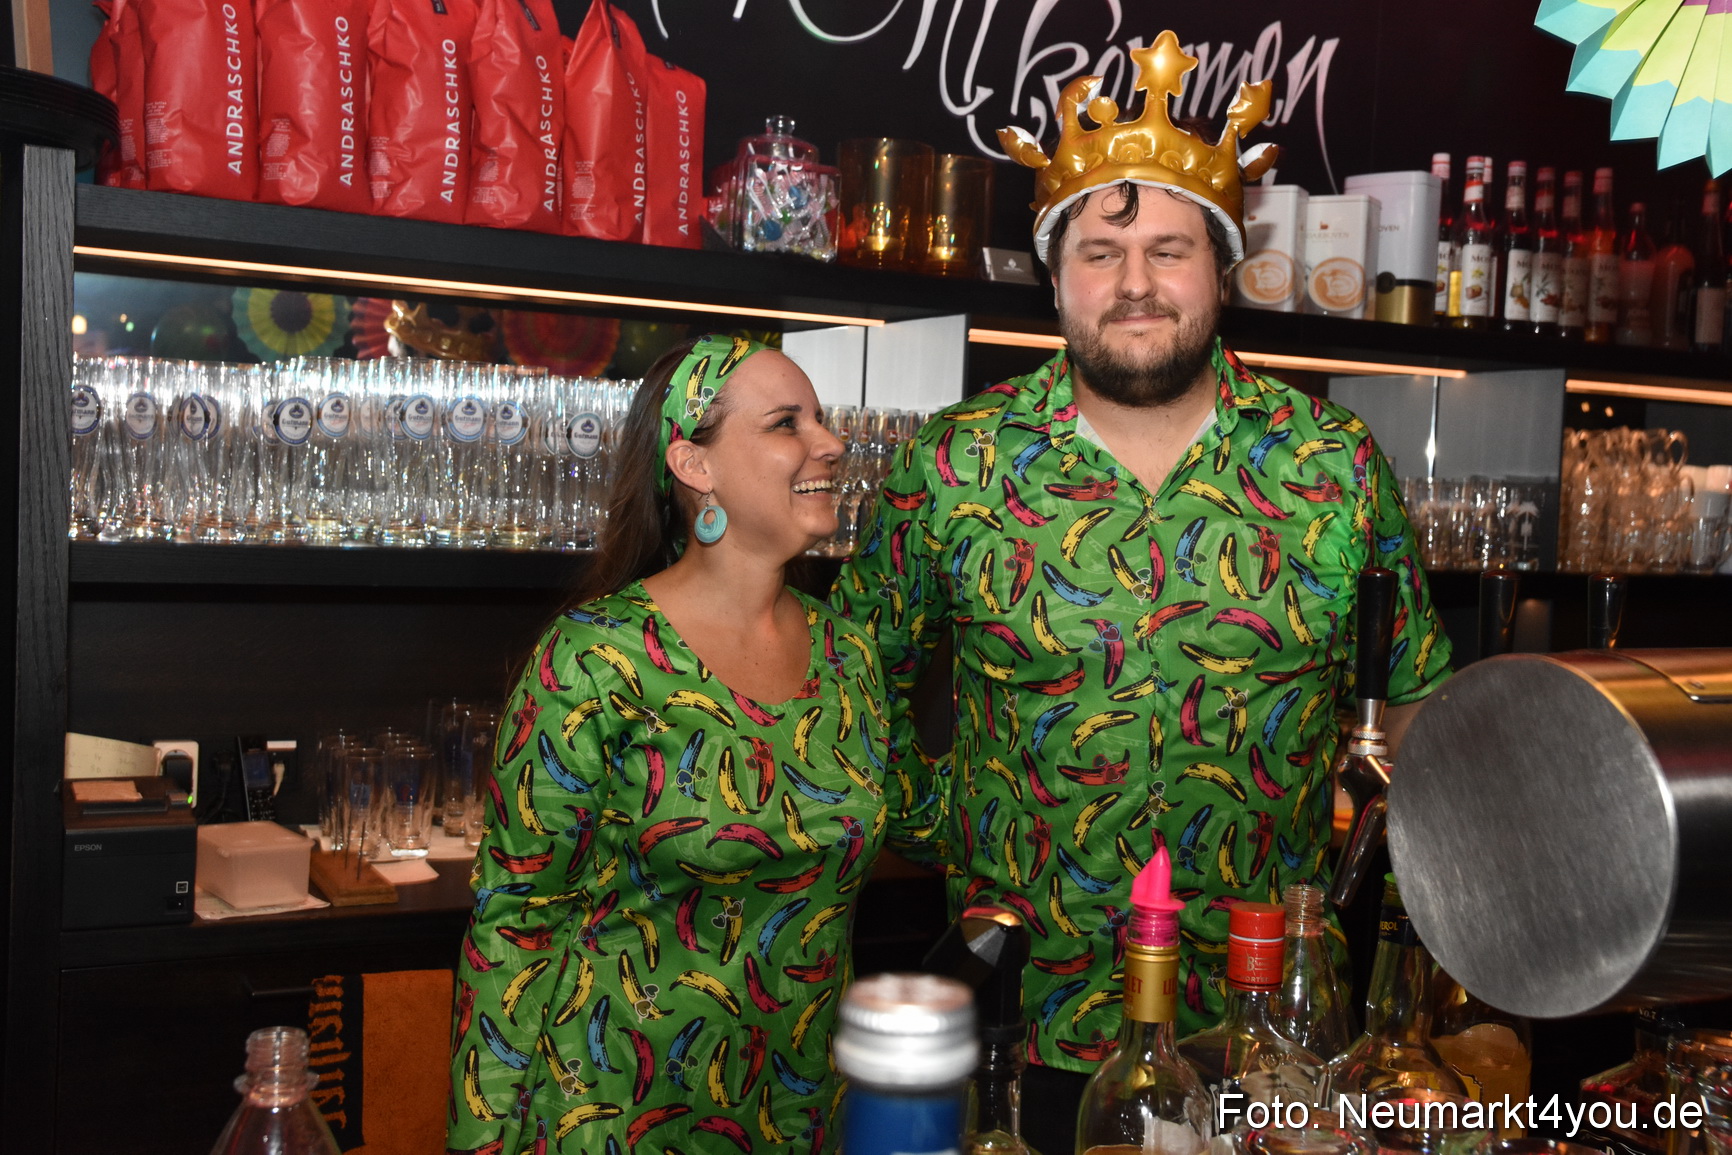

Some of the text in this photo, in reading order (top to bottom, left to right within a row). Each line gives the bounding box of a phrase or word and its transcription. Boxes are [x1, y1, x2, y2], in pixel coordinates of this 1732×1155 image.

[222, 3, 244, 175] ANDRASCHKO
[334, 16, 354, 186] ANDRASCHKO
[440, 38, 461, 204] ANDRASCHKO
[535, 55, 557, 212] ANDRASCHKO
[626, 71, 646, 225] ANDRASCHKO
[676, 90, 690, 236] ANDRASCHKO
